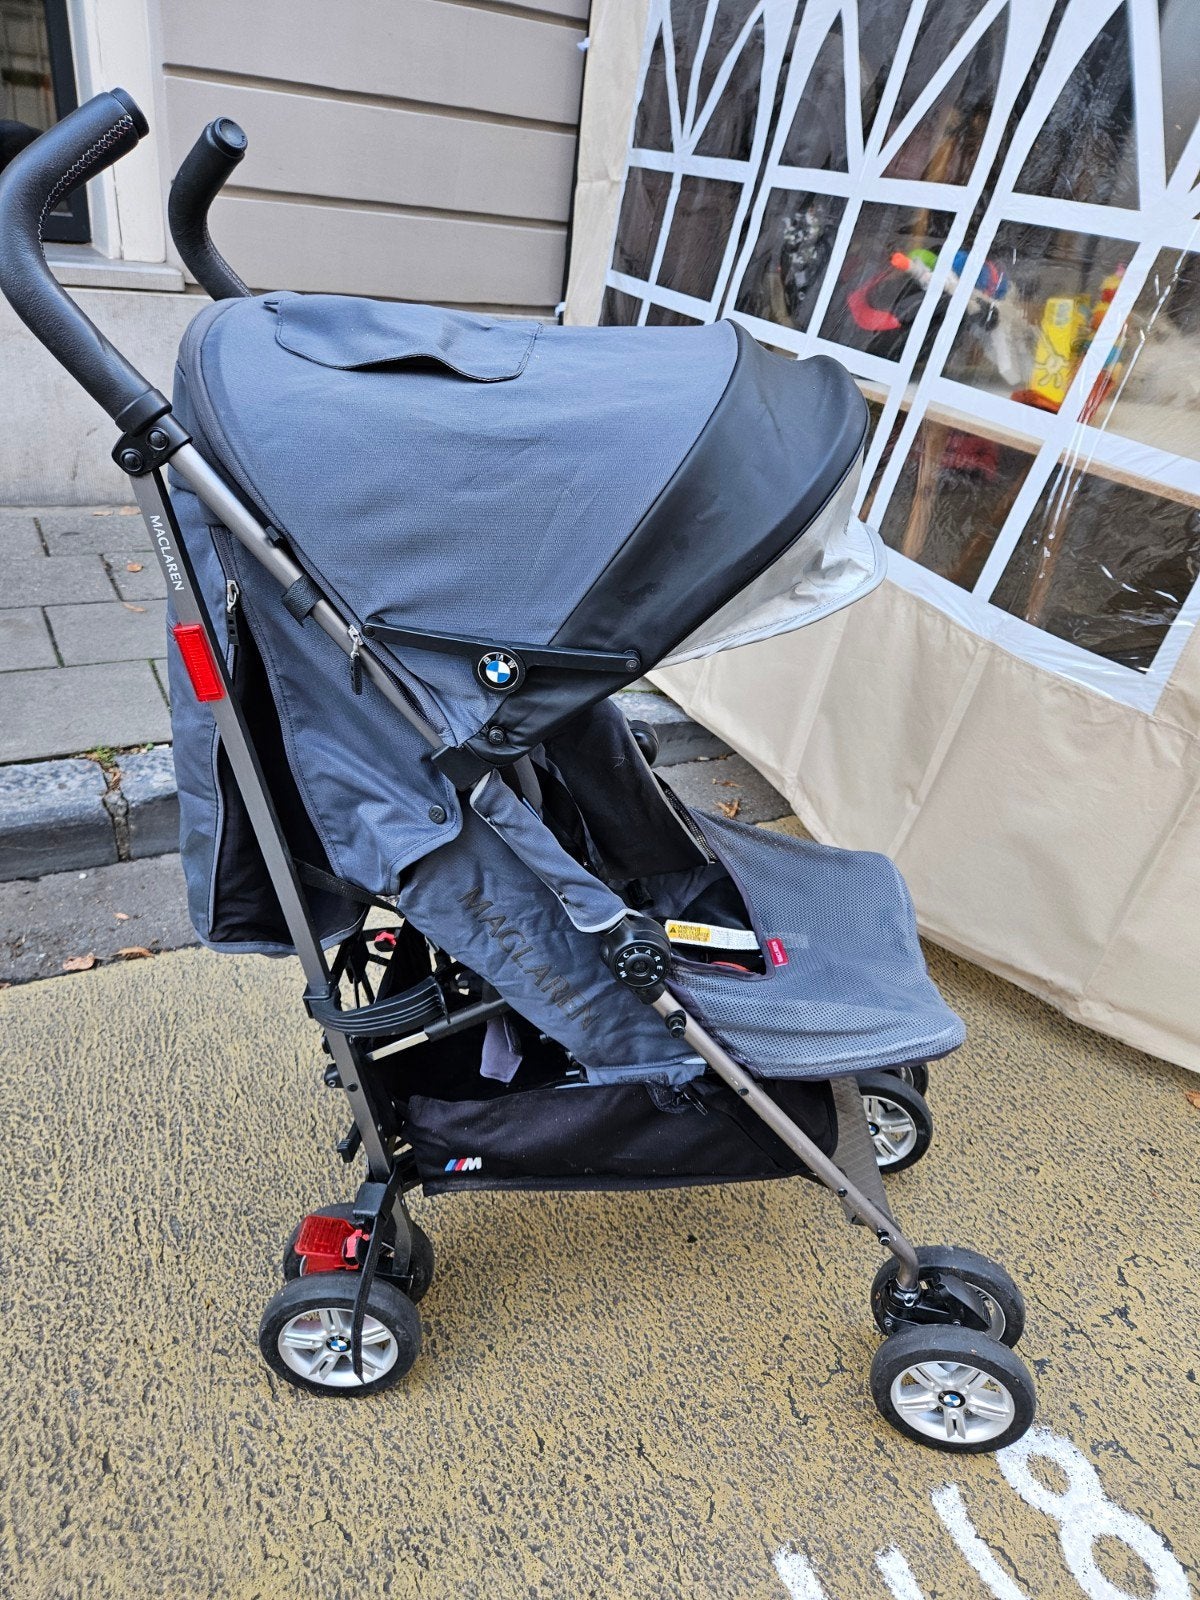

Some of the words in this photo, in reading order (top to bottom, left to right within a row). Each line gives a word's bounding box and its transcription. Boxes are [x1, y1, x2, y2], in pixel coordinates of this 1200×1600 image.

[150, 515, 185, 590] MACLAREN
[457, 886, 601, 1031] MACLAREN
[617, 948, 663, 980] MACLAREN
